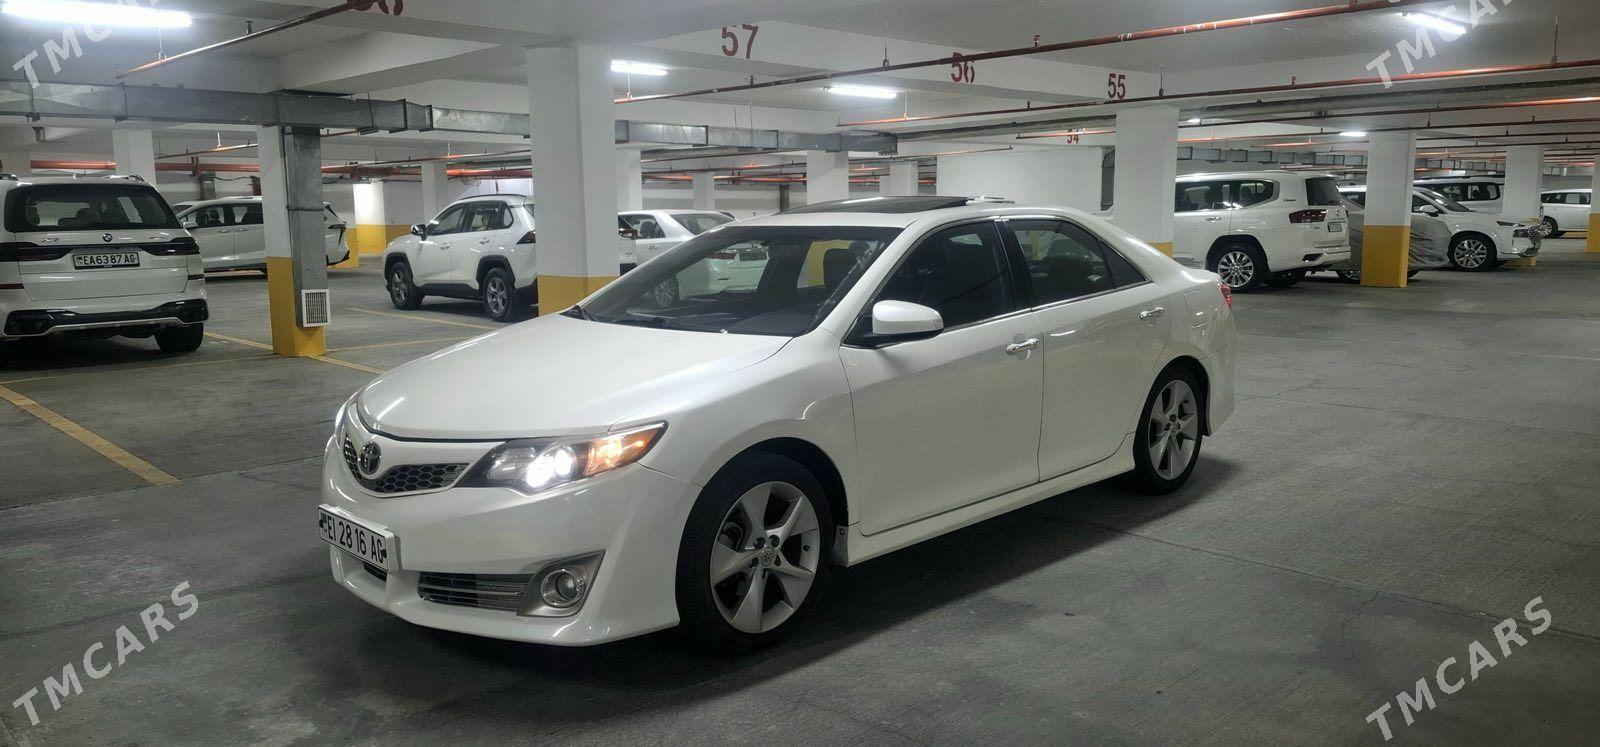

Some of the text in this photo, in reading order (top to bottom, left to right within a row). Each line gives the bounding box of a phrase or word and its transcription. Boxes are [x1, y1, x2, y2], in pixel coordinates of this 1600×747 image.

[721, 24, 758, 59] 57
[951, 52, 975, 83] 56
[1107, 73, 1126, 99] 55
[339, 521, 353, 549] 28
[355, 528, 367, 555] 16
[371, 535, 385, 564] AG
